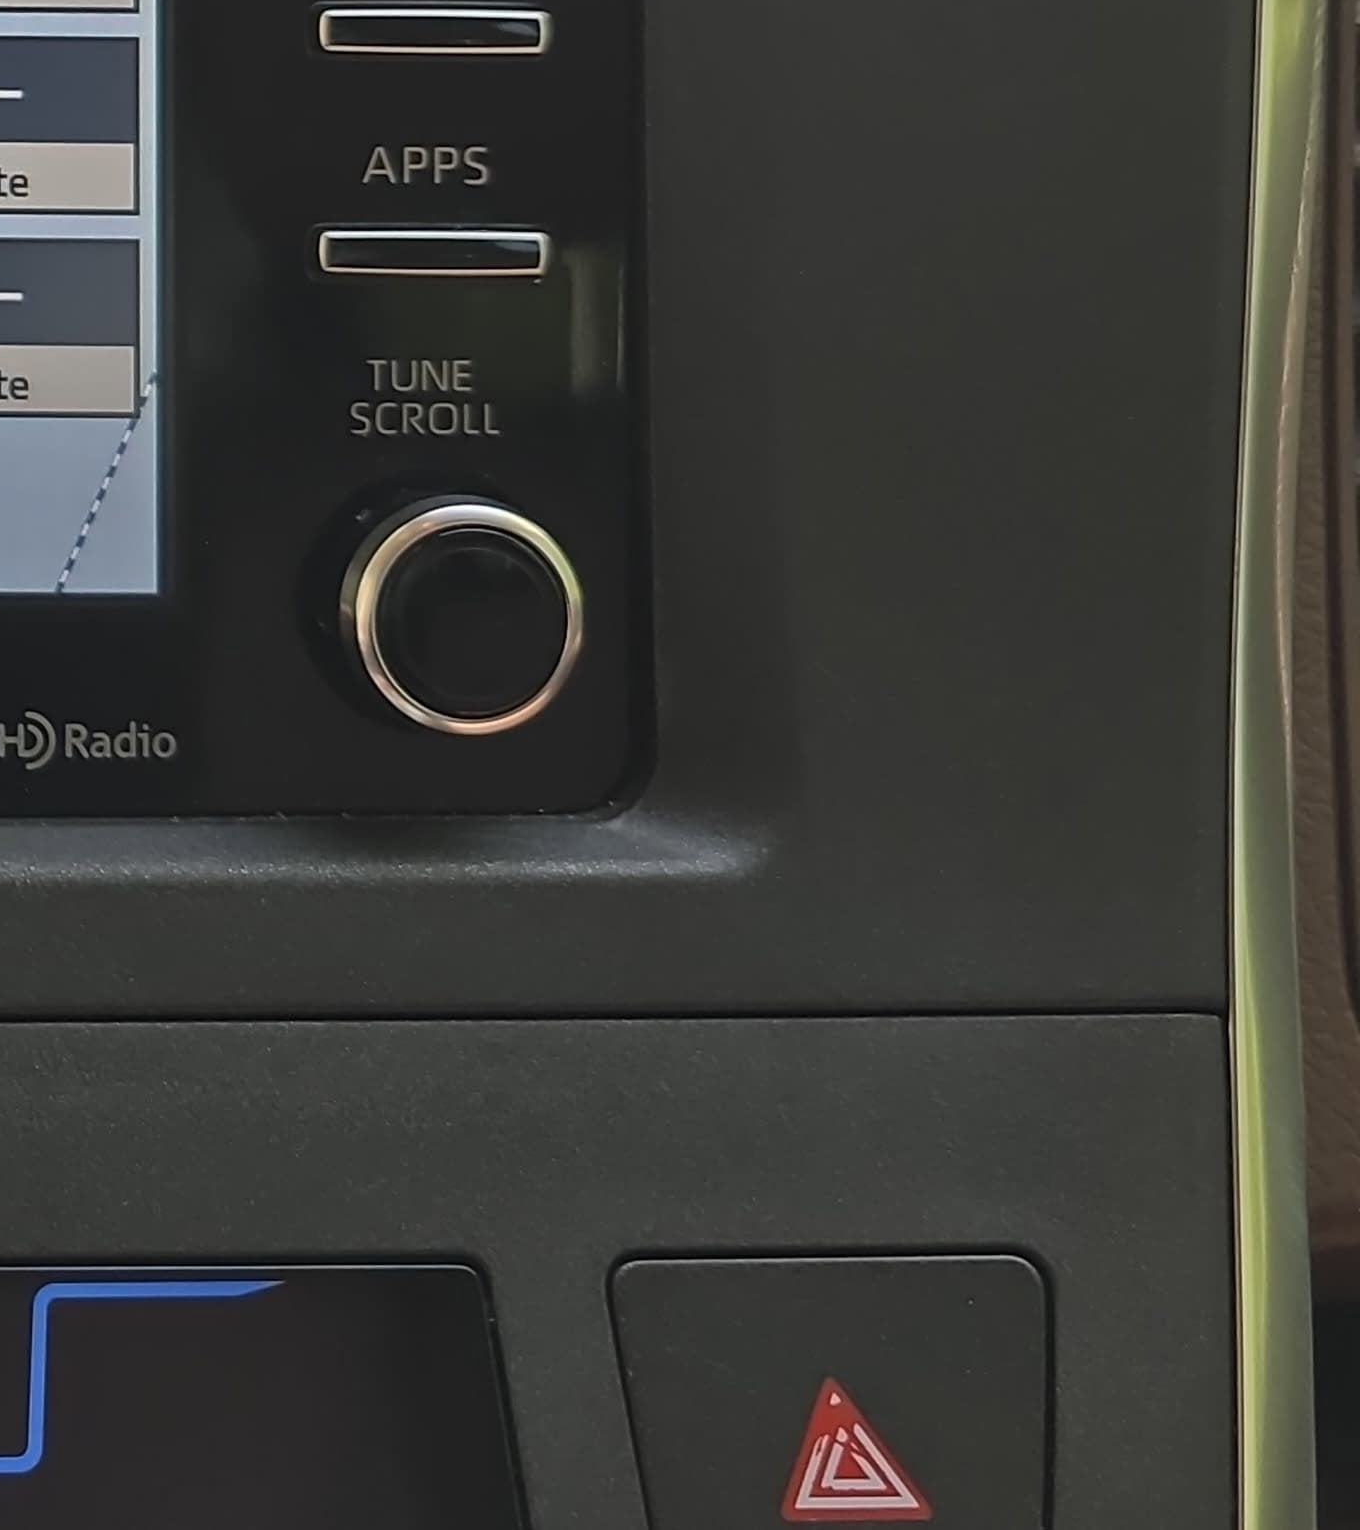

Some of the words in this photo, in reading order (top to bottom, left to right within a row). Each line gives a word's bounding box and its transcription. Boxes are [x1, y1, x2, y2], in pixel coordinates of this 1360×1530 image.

[361, 145, 491, 186] APPS
[365, 358, 473, 392] TUNE
[348, 401, 502, 437] SCROLL
[64, 720, 177, 760] Radio
